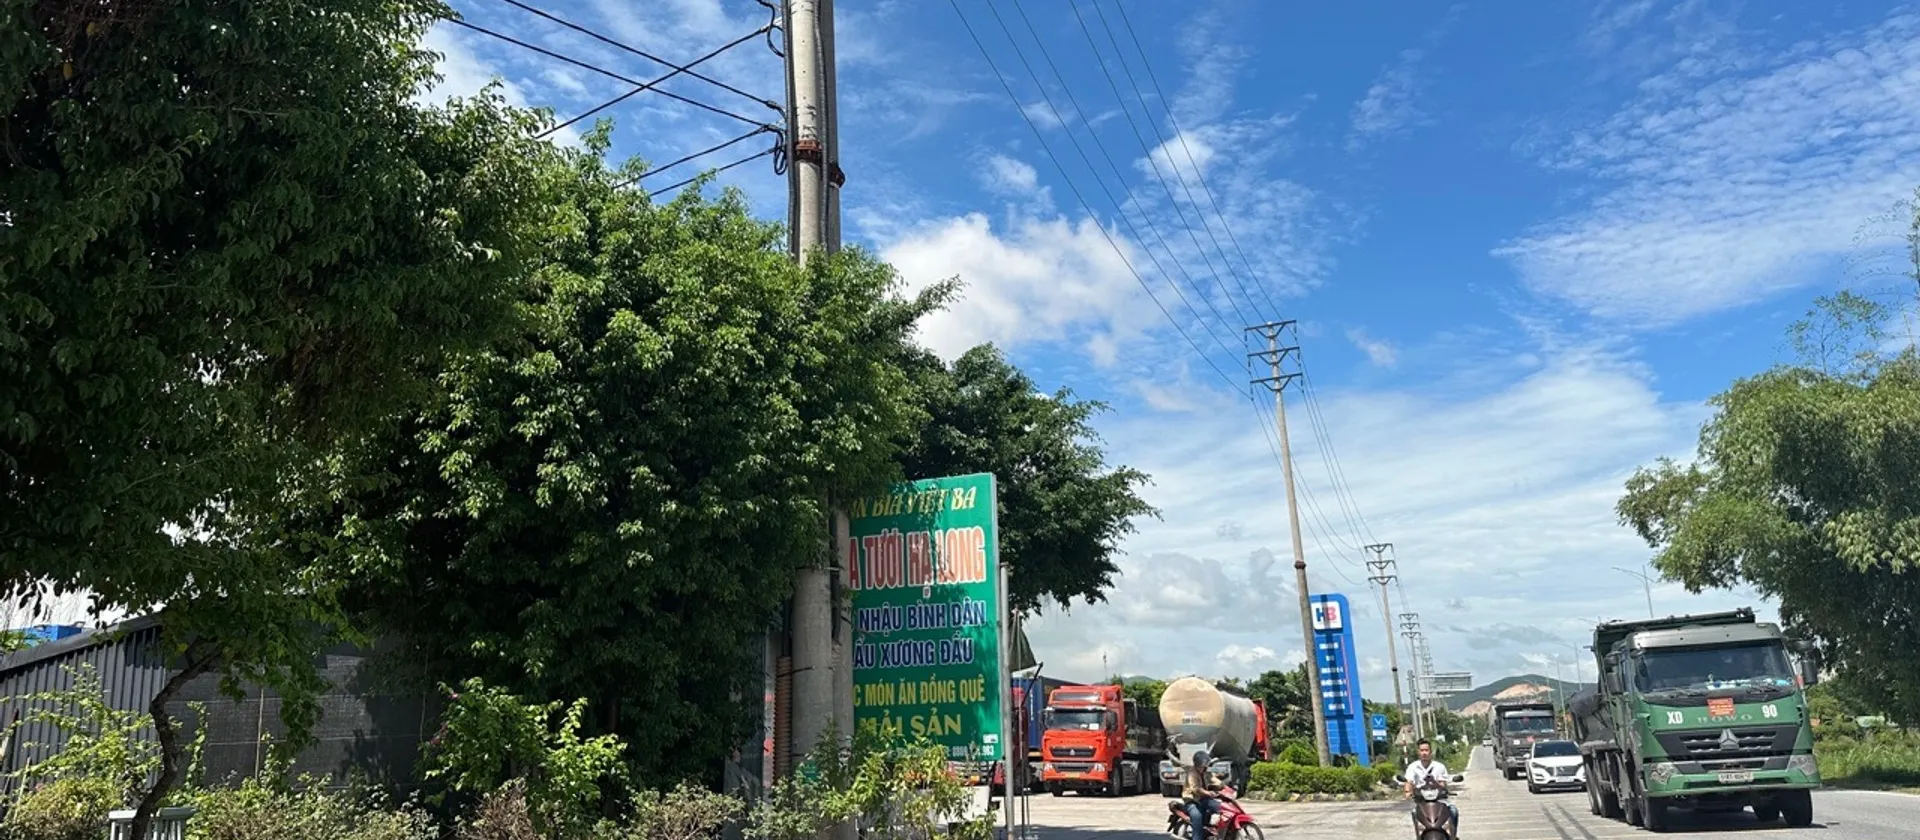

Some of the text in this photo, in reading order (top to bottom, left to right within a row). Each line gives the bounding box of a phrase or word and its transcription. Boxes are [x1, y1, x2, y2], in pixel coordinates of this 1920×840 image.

[951, 486, 977, 511] BA
[863, 528, 905, 590] TƯƠI
[906, 530, 934, 598] HẠ
[935, 525, 986, 585] LONG
[858, 596, 986, 636] NHẬU BÌNH DÂN
[879, 638, 936, 669] XƯƠNG
[865, 678, 895, 707] MÓN
[898, 677, 916, 706] ĂN
[920, 673, 956, 704] ĐỒNG
[959, 674, 986, 705] QUÊ
[910, 707, 962, 736] SẢN
[1762, 704, 1777, 719] 90
